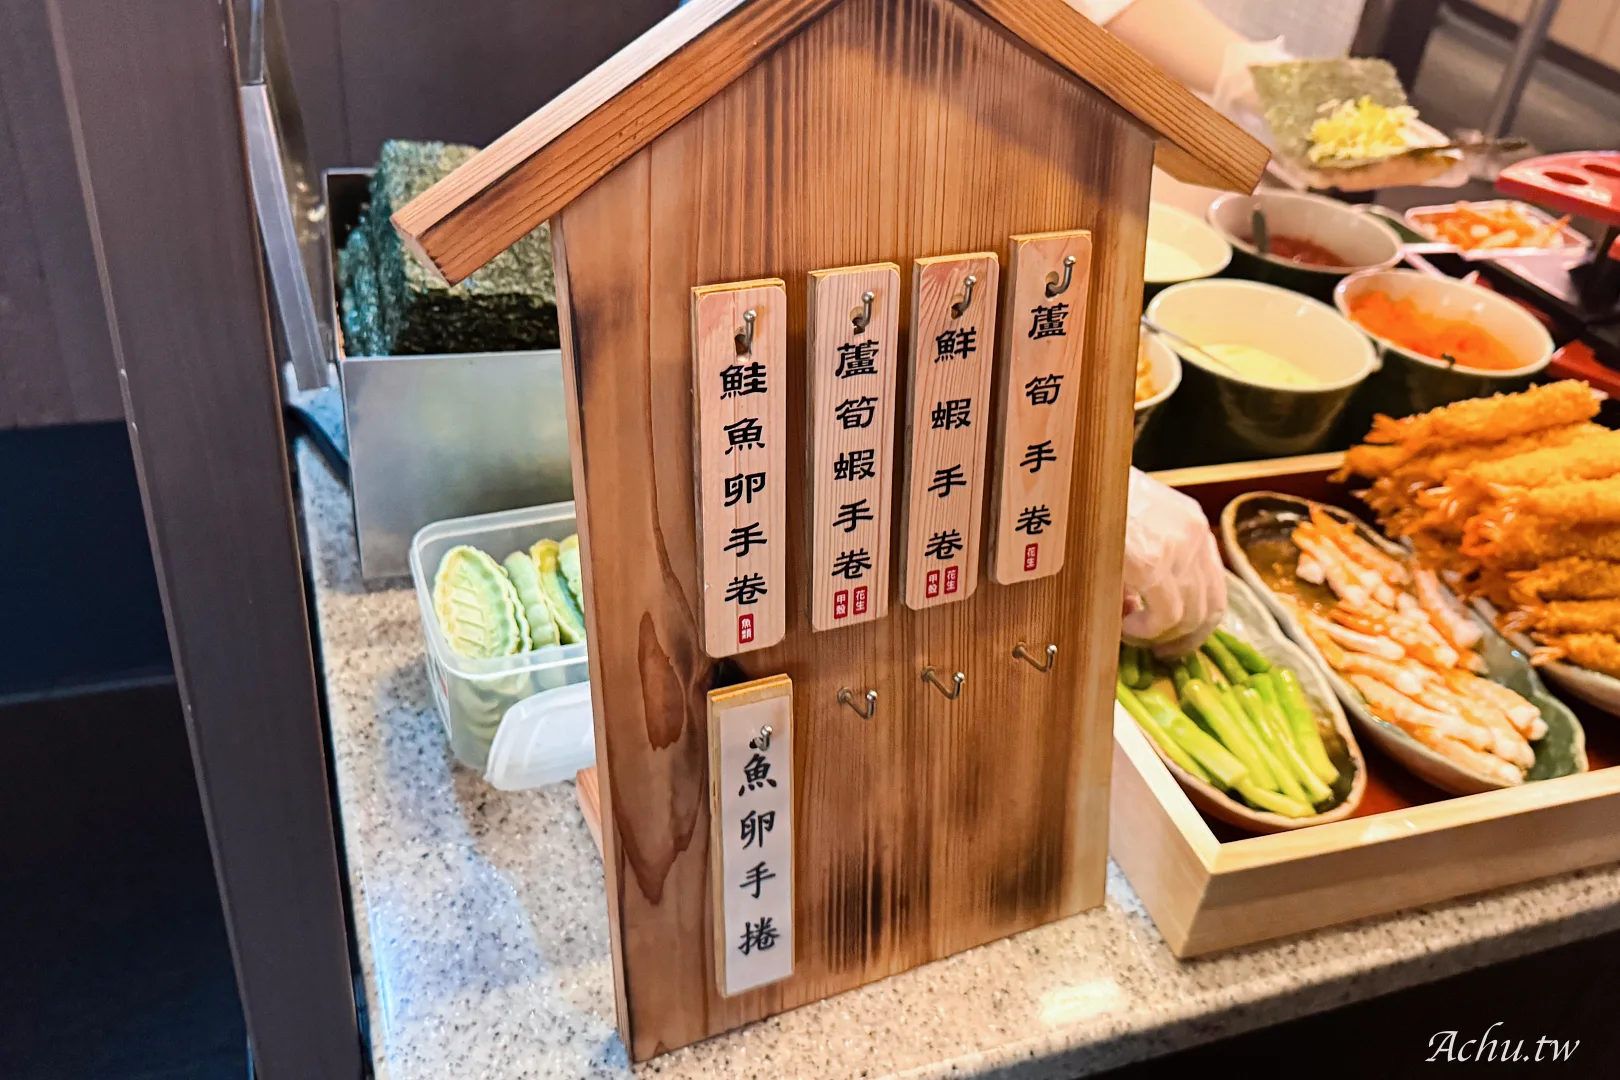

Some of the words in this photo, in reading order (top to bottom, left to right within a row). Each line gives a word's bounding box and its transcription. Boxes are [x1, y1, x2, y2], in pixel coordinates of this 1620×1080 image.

[719, 361, 768, 605] 鮭魚卵手卷
[831, 340, 880, 580] 蘆筍蝦手卷
[924, 326, 978, 560] 鮮蝦手卷
[1014, 302, 1070, 536] 蘆筍手卷
[855, 590, 866, 612] 花生
[945, 569, 956, 591] 花生
[1026, 547, 1036, 569] 花生
[738, 753, 780, 956] 魚卵手捲
